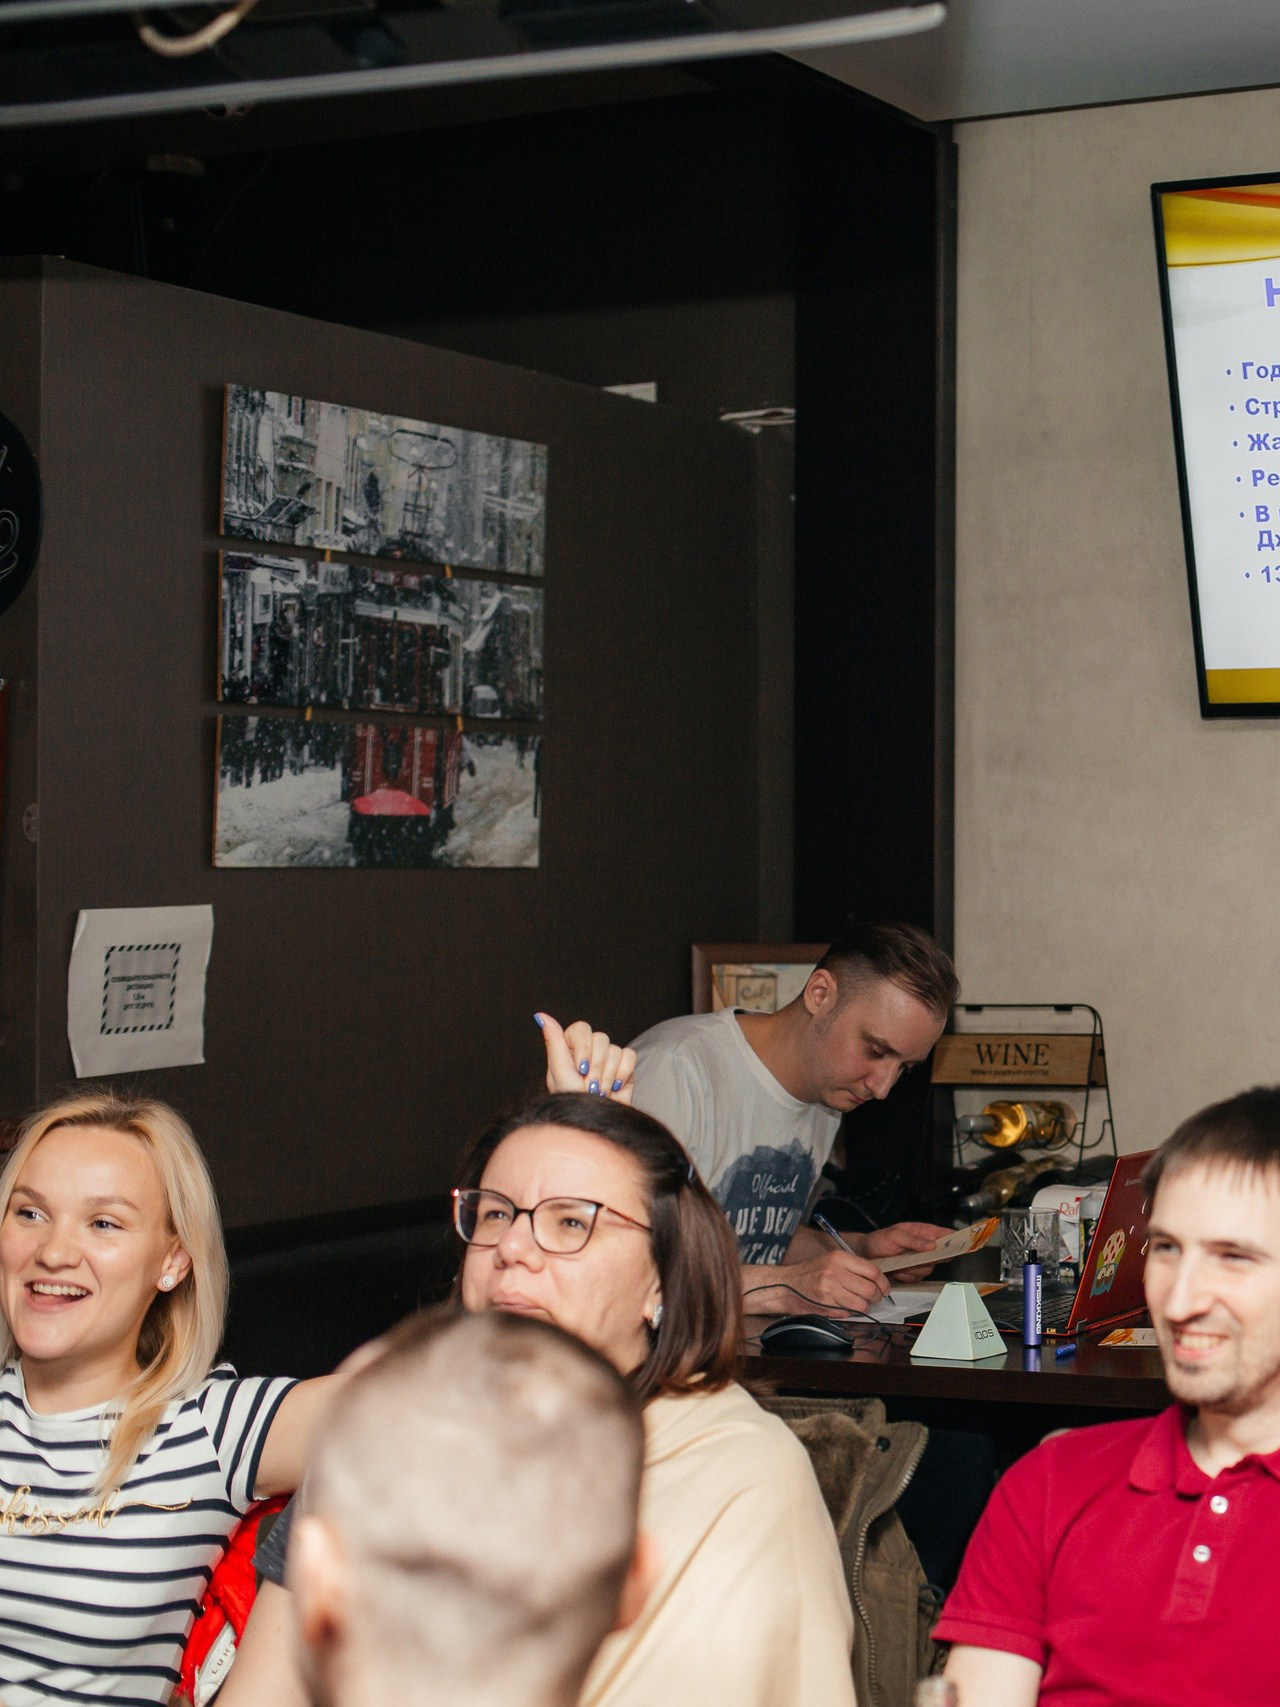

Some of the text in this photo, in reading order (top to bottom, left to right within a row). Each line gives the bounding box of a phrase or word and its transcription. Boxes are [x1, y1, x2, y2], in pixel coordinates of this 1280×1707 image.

[1255, 503, 1271, 524] В
[975, 1042, 1050, 1066] WINE
[751, 1173, 799, 1199] Official
[973, 1328, 995, 1341] IQOS
